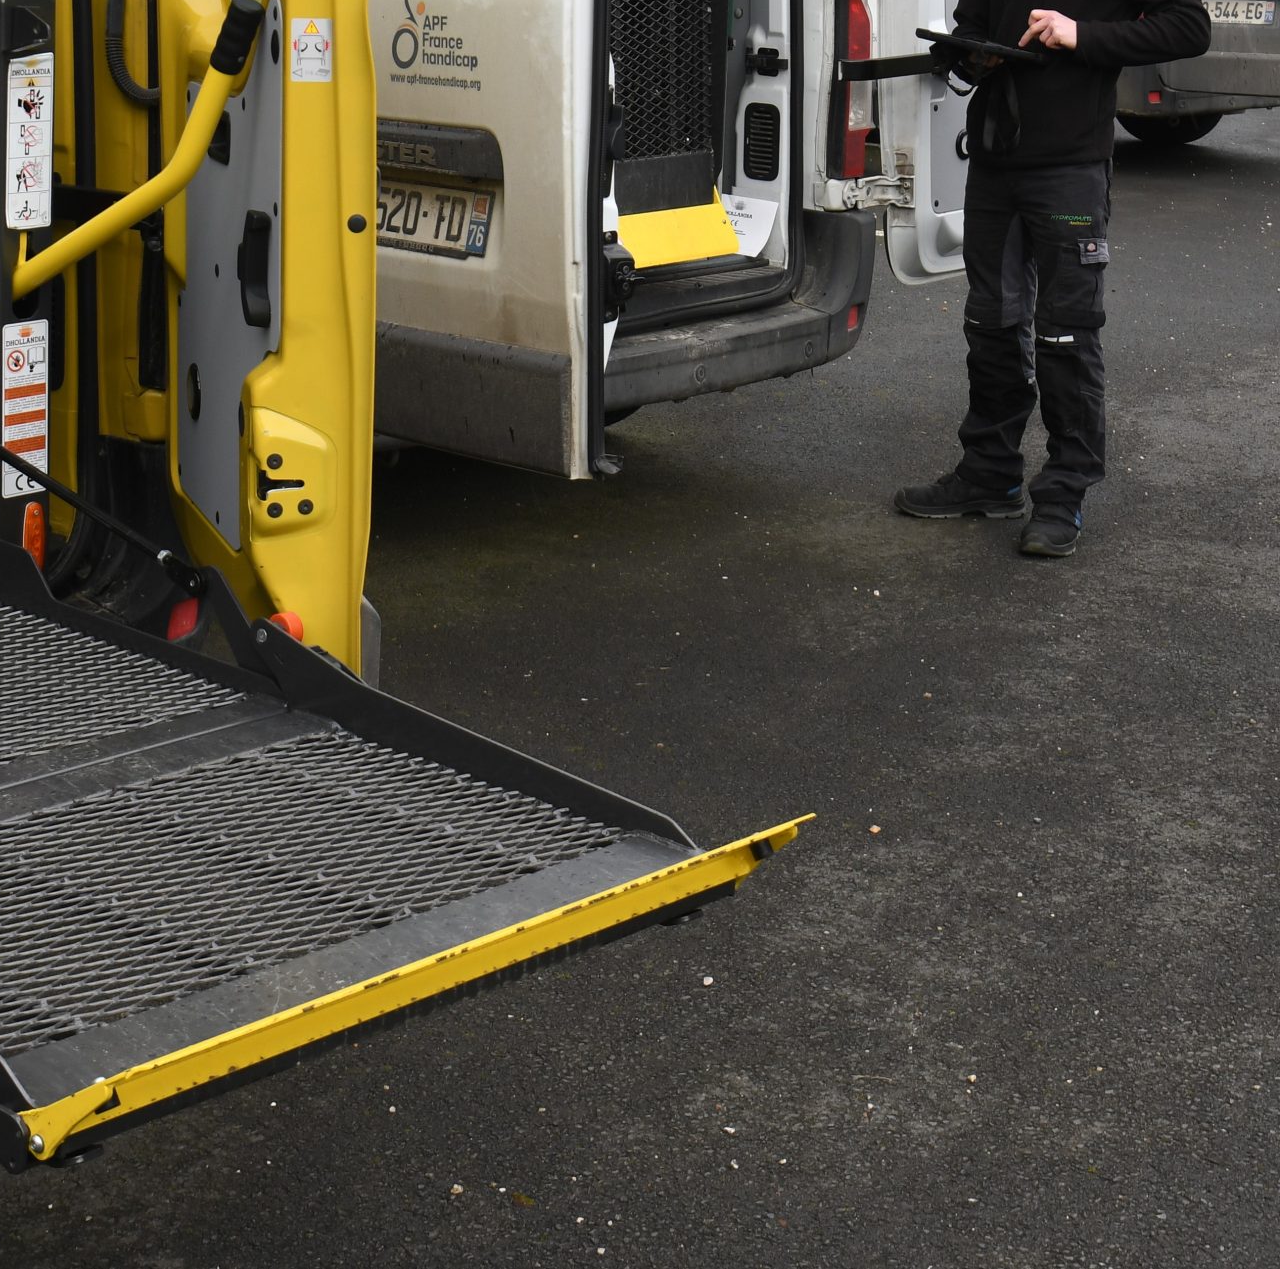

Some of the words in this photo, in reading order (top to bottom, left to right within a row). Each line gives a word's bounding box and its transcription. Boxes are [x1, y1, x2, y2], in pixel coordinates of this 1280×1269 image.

[423, 15, 448, 31] APF
[422, 32, 463, 49] France
[422, 49, 478, 71] handicap
[12, 68, 51, 76] DHOLLANDIA
[468, 223, 485, 247] 76
[5, 335, 46, 347] DHOLLANDIA
